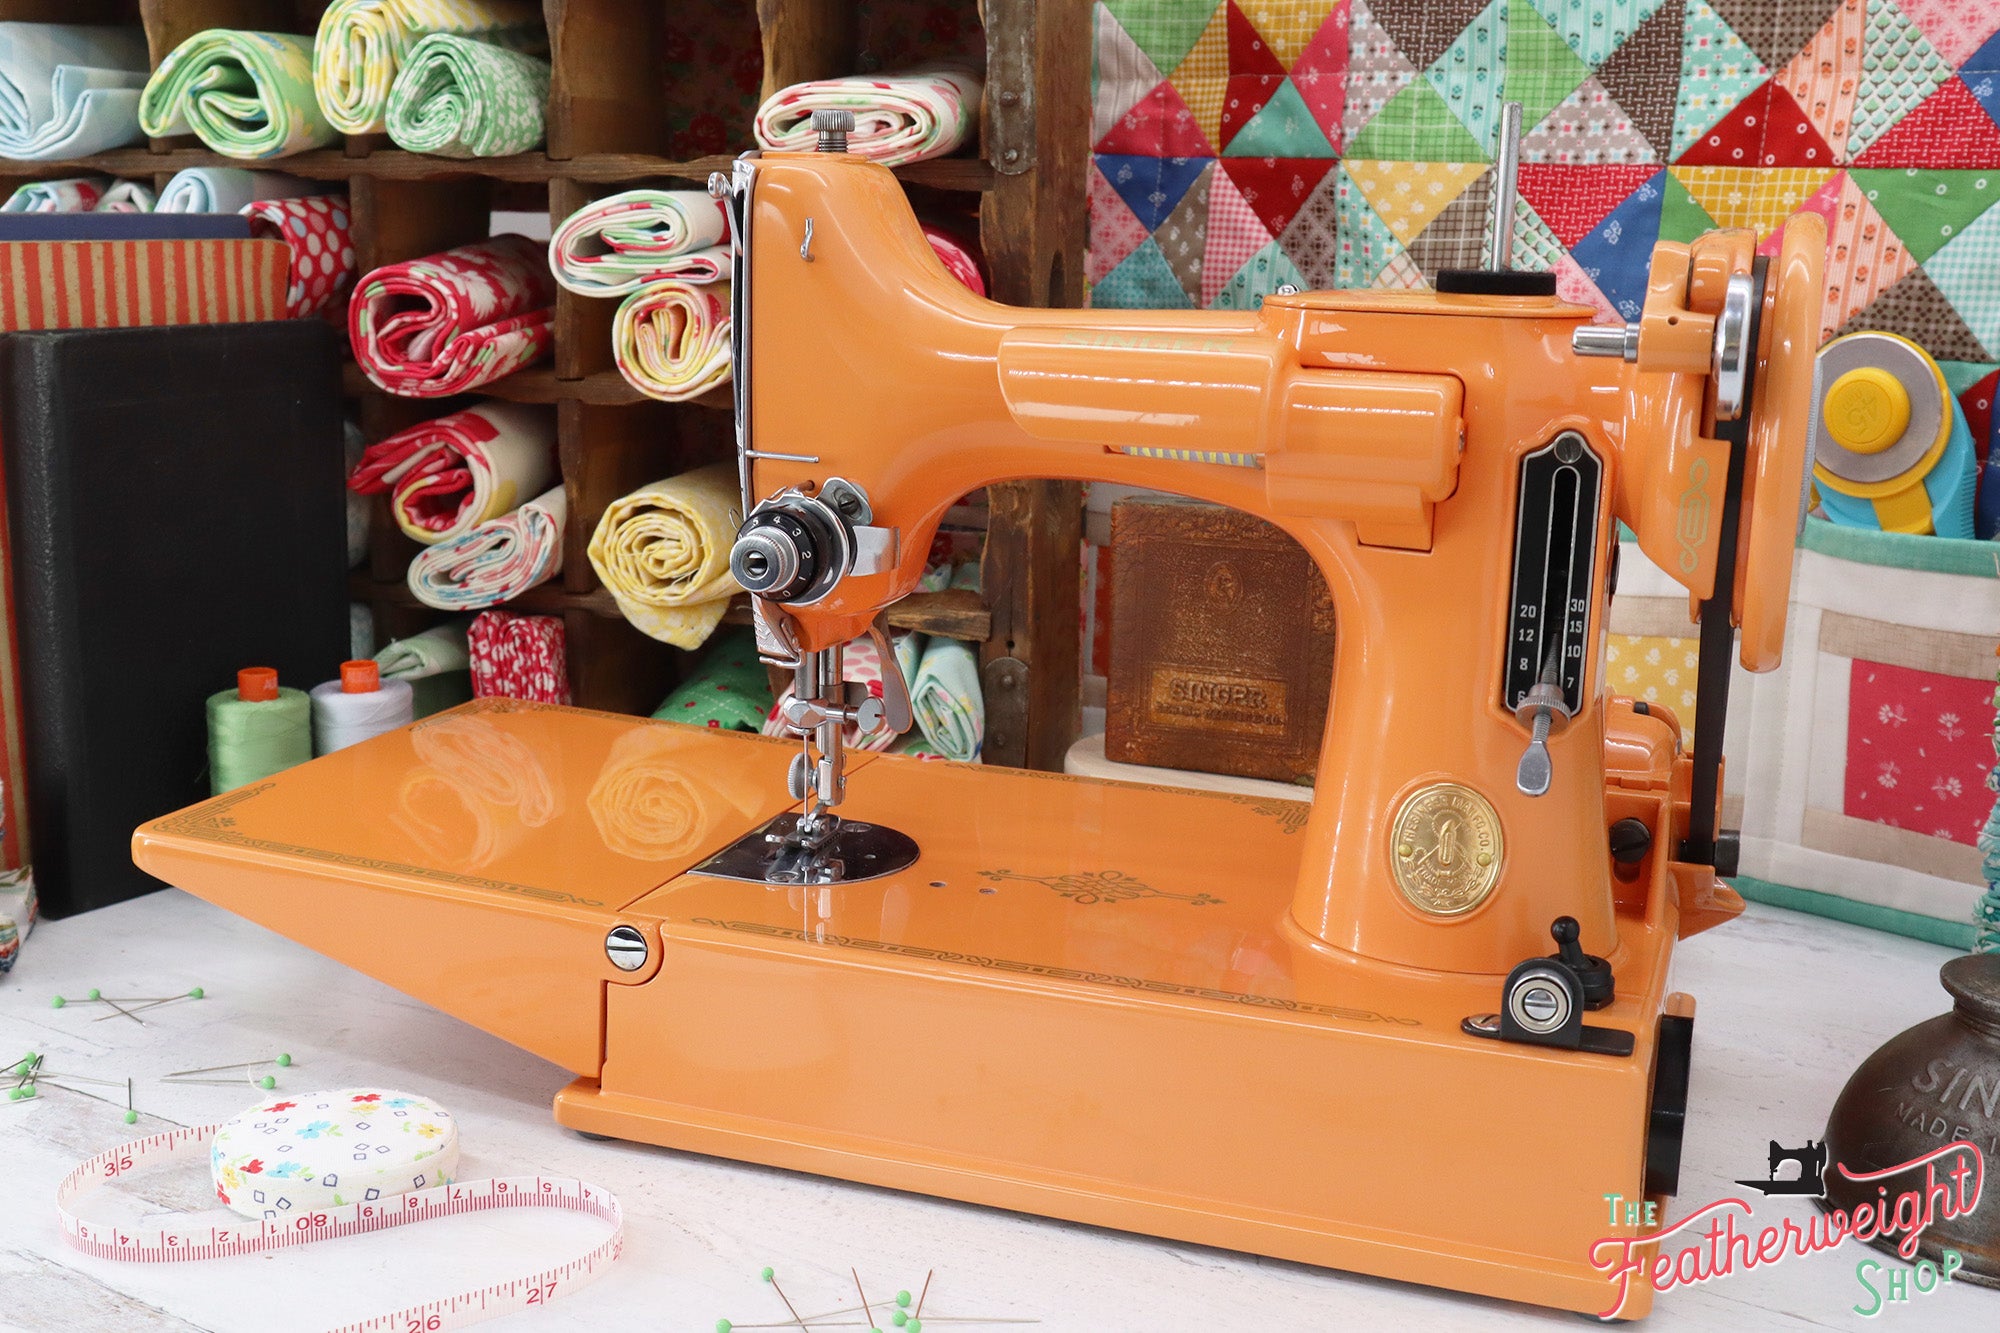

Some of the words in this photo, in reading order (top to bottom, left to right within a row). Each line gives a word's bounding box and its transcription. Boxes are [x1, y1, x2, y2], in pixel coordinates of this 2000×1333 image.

[752, 515, 759, 526] 5
[773, 515, 781, 525] 4
[792, 528, 802, 537] 3
[802, 550, 812, 559] 2
[1520, 605, 1536, 618] 20
[1570, 599, 1585, 613] 30
[1569, 621, 1582, 633] 15
[1519, 629, 1534, 642] 12
[1567, 645, 1581, 658] 10
[1520, 658, 1528, 671] 8
[1567, 677, 1575, 689] 7
[1170, 678, 1268, 710] SINGER
[1911, 1061, 2000, 1119] SIN
[104, 1155, 133, 1177] 35
[498, 1182, 508, 1193] 6
[543, 1182, 552, 1193] 5
[584, 1188, 592, 1199] 4
[453, 1188, 462, 1200] 7
[408, 1197, 418, 1208] 8
[363, 1207, 373, 1217] 9
[296, 1214, 328, 1231] 80
[80, 1227, 88, 1239] 5
[271, 1225, 278, 1235] 1
[120, 1235, 130, 1246] 4
[167, 1235, 178, 1247] 3
[218, 1231, 230, 1243] 2
[526, 1282, 558, 1305] 27
[406, 1314, 442, 1333] 26
